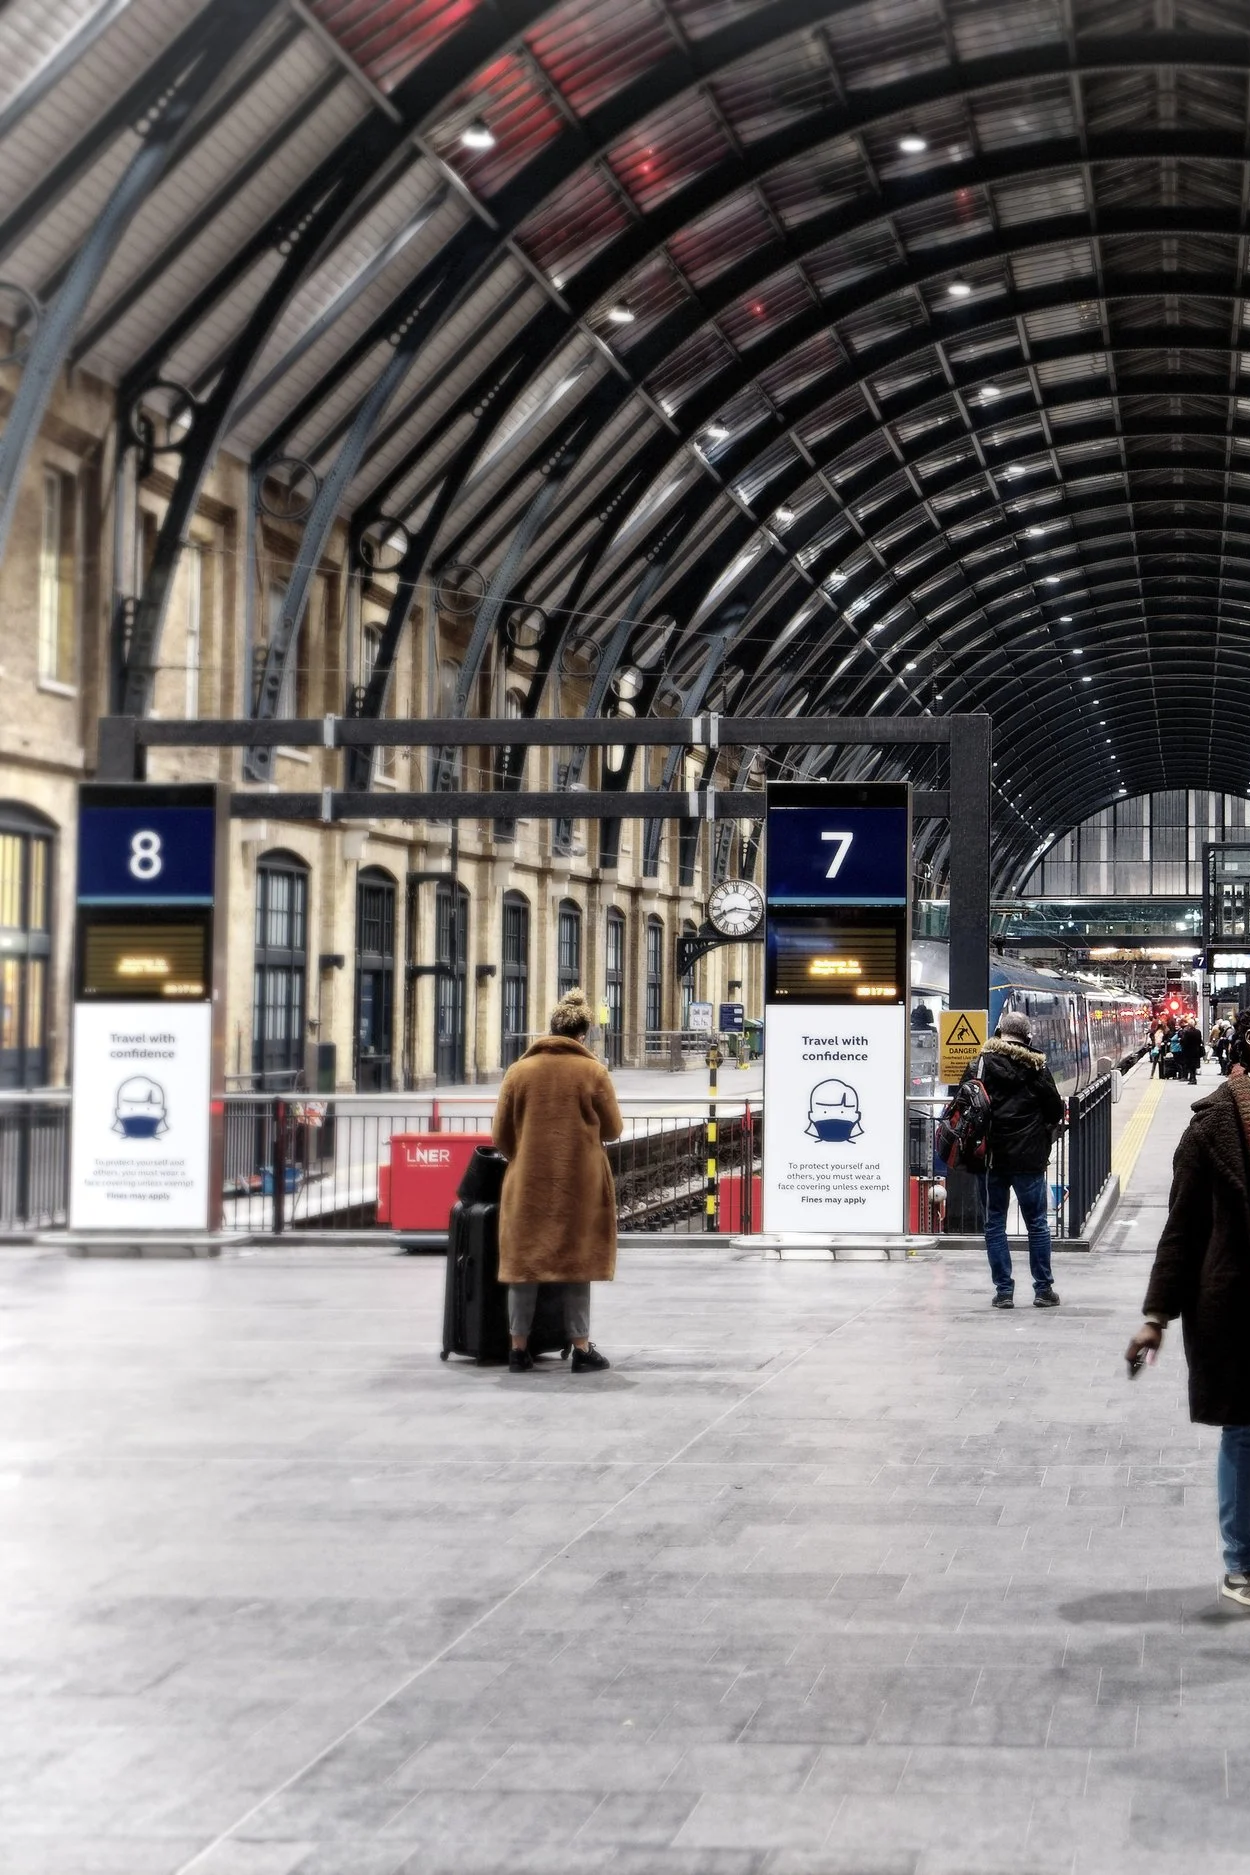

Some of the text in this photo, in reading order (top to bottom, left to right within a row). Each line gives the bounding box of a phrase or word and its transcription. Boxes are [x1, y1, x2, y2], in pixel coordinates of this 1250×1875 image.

[130, 830, 162, 879] 8
[821, 831, 854, 879] 7
[1197, 957, 1205, 967] 7
[109, 1033, 175, 1043] Travel with
[801, 1035, 869, 1046] Travel with
[110, 1048, 175, 1058] confidence
[802, 1050, 868, 1061] confidence
[406, 1146, 450, 1164] LNER
[105, 1159, 134, 1168] protect
[136, 1159, 168, 1168] yourself
[788, 1162, 880, 1171] To protect yourself and
[786, 1173, 815, 1181] others,
[778, 1182, 795, 1190] face
[796, 1183, 831, 1192] covering
[129, 1192, 147, 1200] may
[148, 1192, 170, 1200] apply
[801, 1195, 867, 1205] Fines may apply
